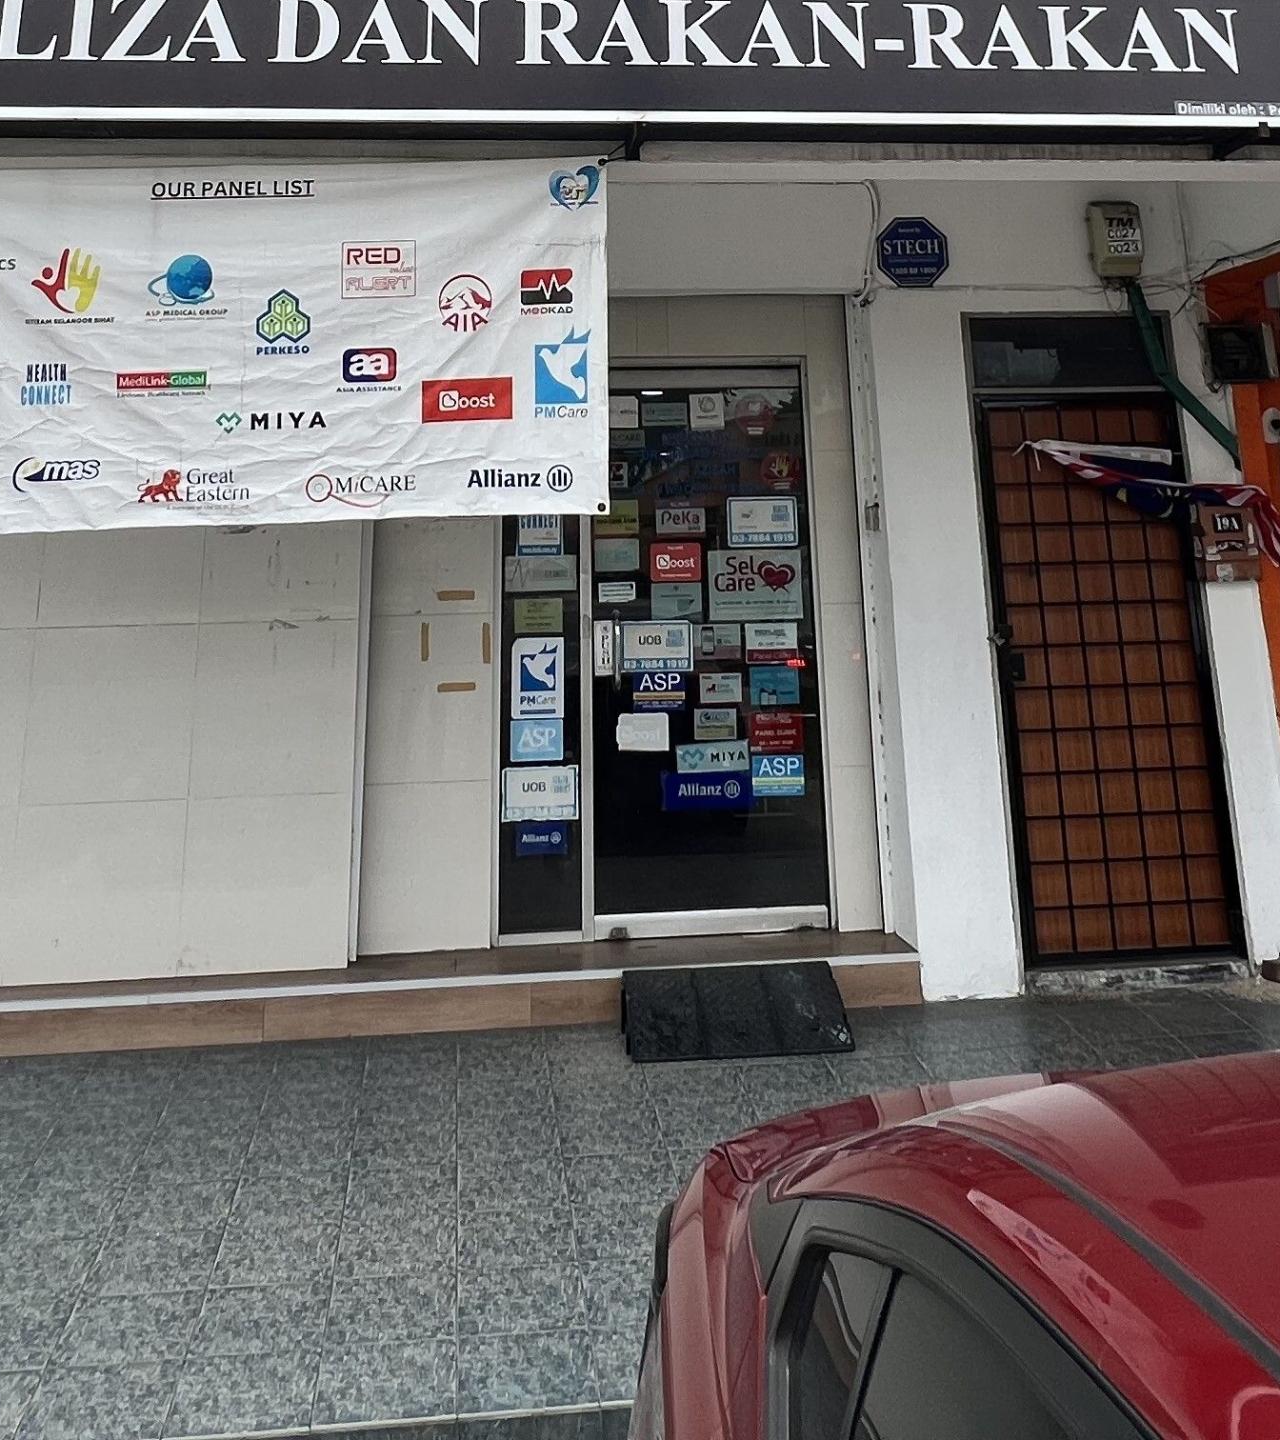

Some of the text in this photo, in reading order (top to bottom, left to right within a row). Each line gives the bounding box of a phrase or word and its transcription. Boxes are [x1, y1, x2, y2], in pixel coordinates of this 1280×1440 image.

[1177, 102, 1227, 115] Dimiliki
[1229, 103, 1257, 116] oleh
[151, 179, 315, 197] OUR PANEL LIST
[883, 239, 940, 255] STECH
[347, 248, 400, 265] RED
[345, 276, 412, 291] ALERT
[145, 308, 228, 318] ASP MEDICAL GROUP
[442, 312, 488, 332] AIA
[256, 345, 310, 356] PERKESO
[349, 352, 389, 376] aa
[26, 363, 67, 383] HEALTH
[119, 373, 205, 389] MediLink-Global
[21, 384, 72, 406] CONNECT
[439, 390, 495, 412] Boost
[534, 404, 589, 420] PMCare
[250, 411, 327, 431] MIYA
[187, 468, 234, 484] Great
[335, 474, 416, 494] MiCARE
[468, 468, 541, 489] Allianz
[186, 486, 250, 502] Eastern
[661, 510, 700, 525] PeKa
[656, 554, 695, 570] Boost
[725, 556, 760, 576] Sel
[714, 573, 756, 593] Care
[638, 635, 661, 646] UOB
[639, 673, 681, 691] ASP
[519, 695, 557, 707] PMCare
[517, 727, 557, 748] ASP
[710, 750, 746, 763] MIYA
[759, 757, 800, 777] ASP
[522, 781, 547, 793] UOB
[678, 783, 722, 797] Allianz
